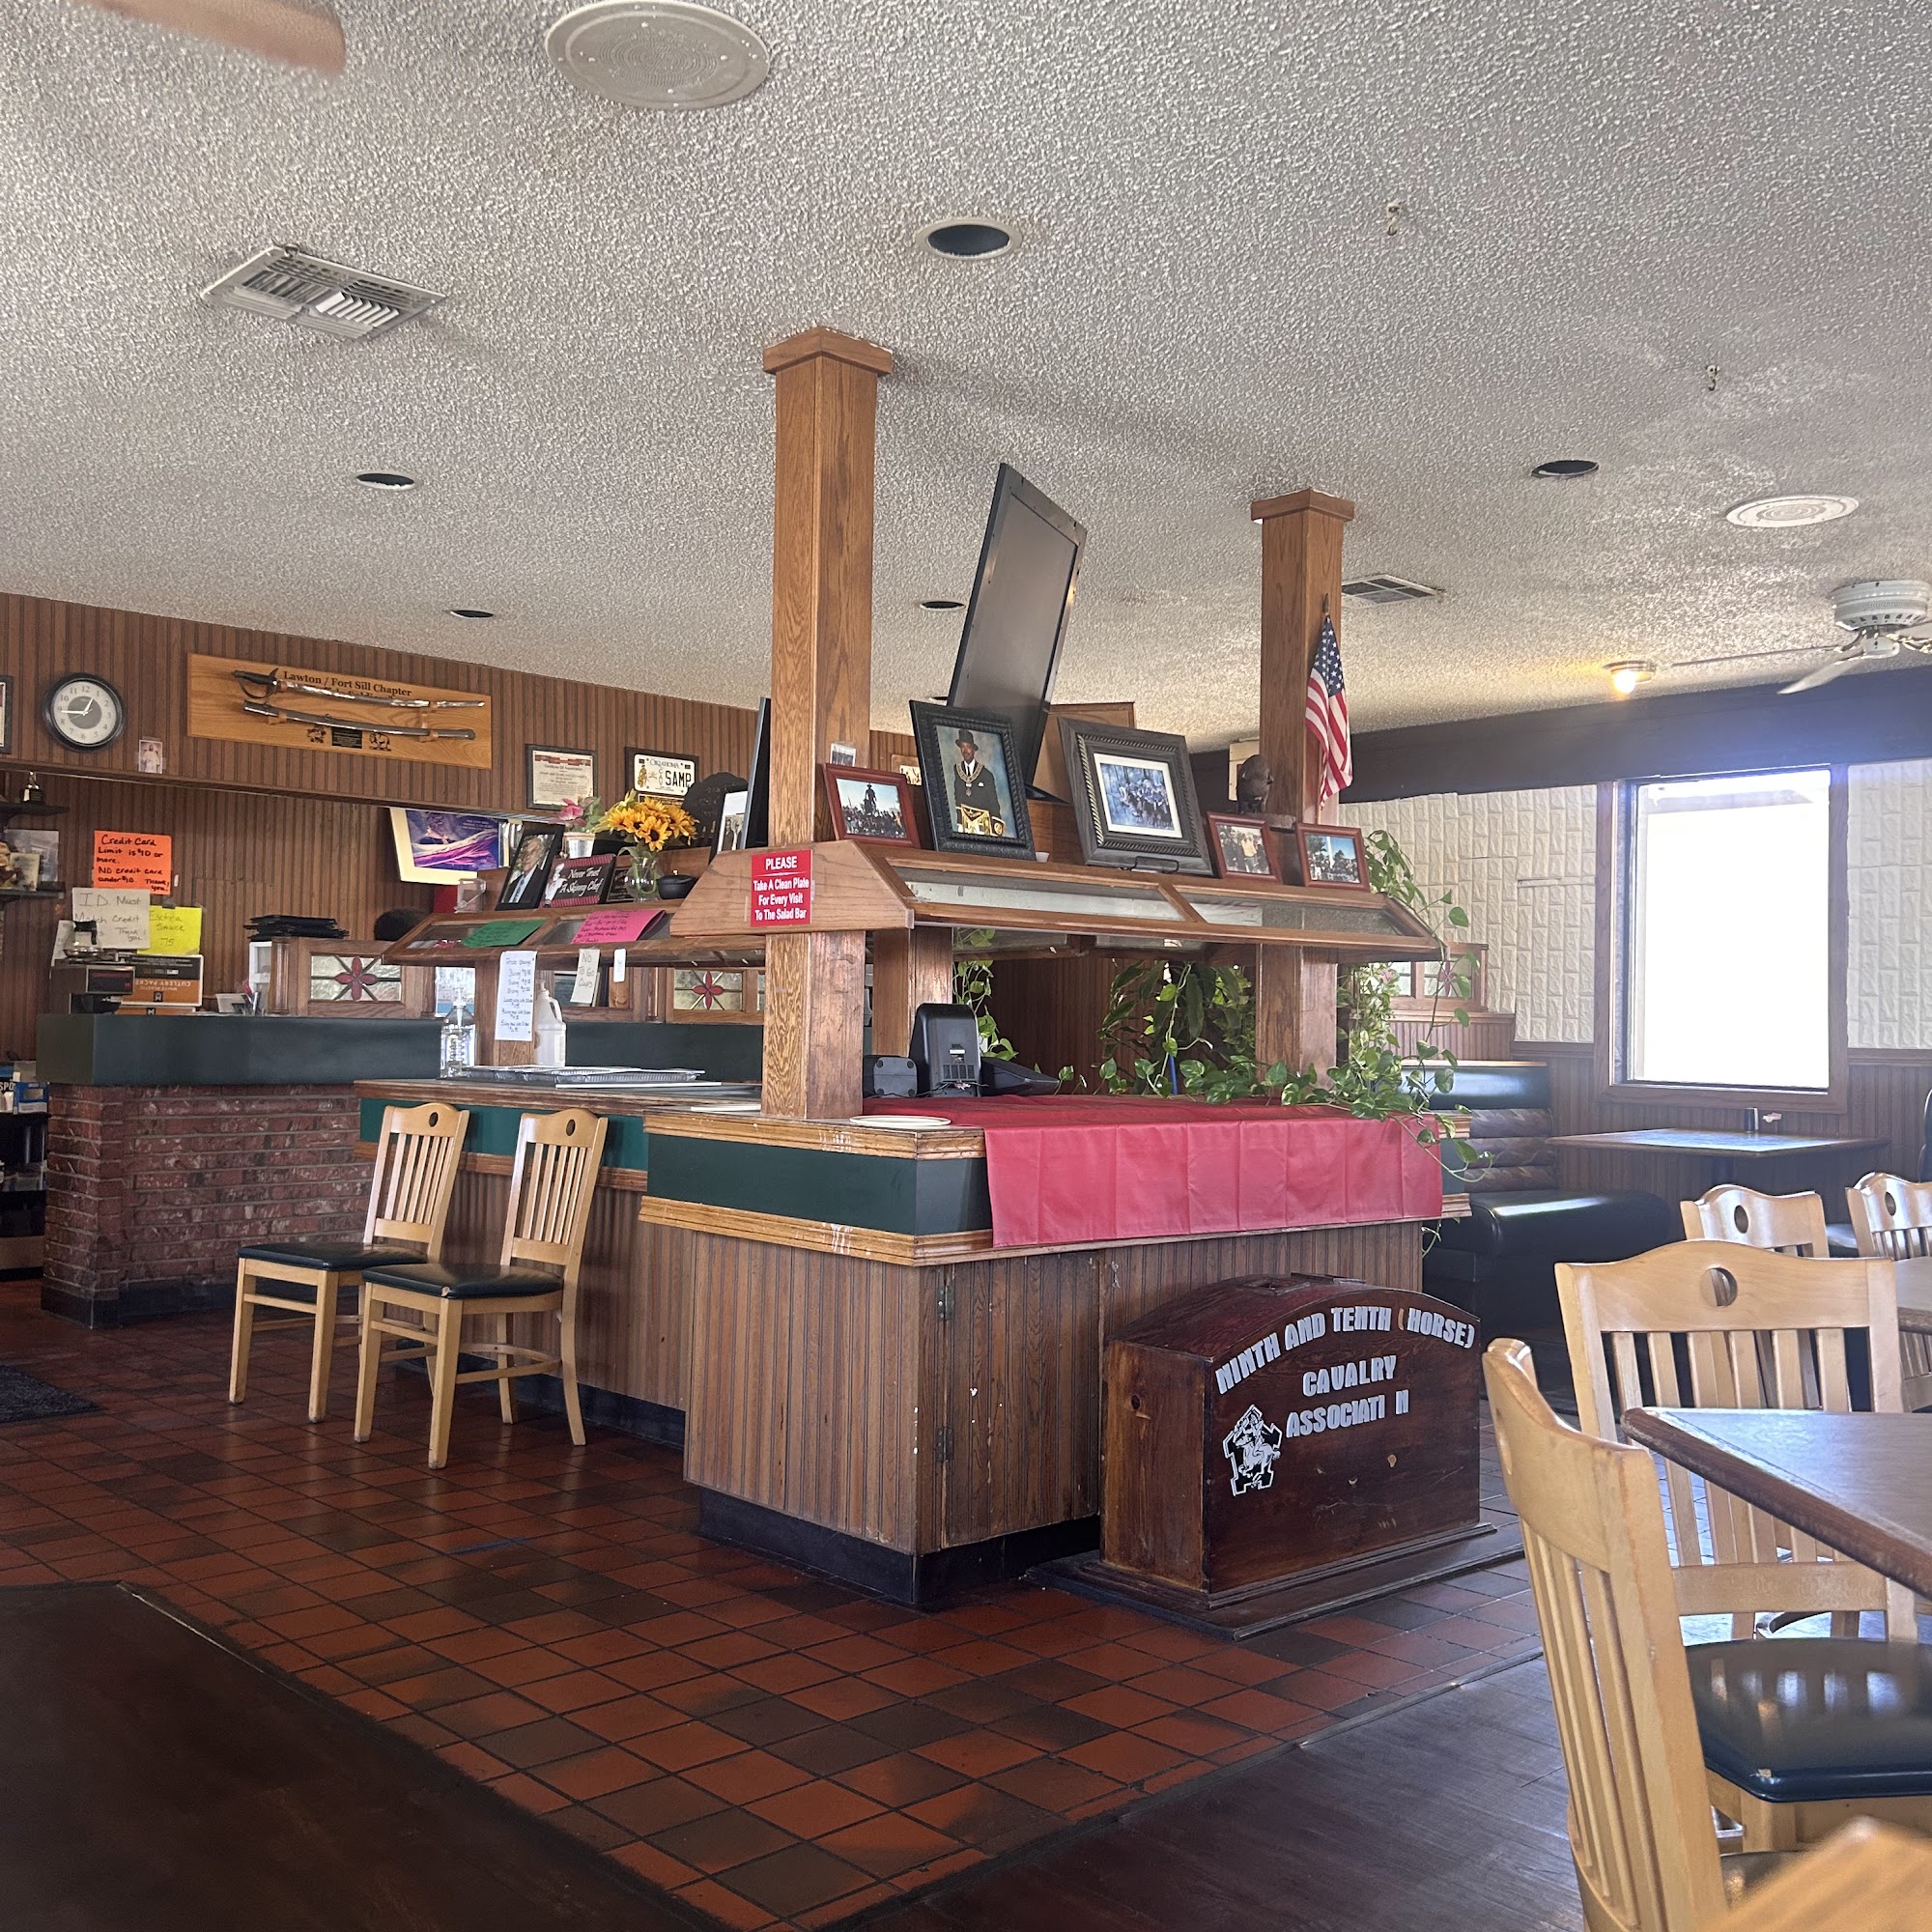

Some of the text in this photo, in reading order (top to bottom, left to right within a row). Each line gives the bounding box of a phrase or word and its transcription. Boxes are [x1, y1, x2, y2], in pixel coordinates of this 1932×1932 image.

[283, 670, 322, 684] Lawton
[324, 676, 329, 686] /
[330, 677, 353, 688] Fort
[355, 680, 371, 692] Sill
[373, 684, 412, 696] Chapter
[101, 834, 156, 846] Credit Card
[137, 848, 151, 857] $10
[765, 856, 798, 870] PLEASE
[568, 866, 603, 879] Never Trust
[559, 882, 568, 894] A
[567, 880, 587, 896] Skinny
[587, 877, 605, 893] Chef
[753, 877, 810, 892] Take A Clean Plate
[117, 895, 142, 906] Must
[758, 893, 803, 907] For Every Visit
[112, 914, 140, 923] Credit
[150, 910, 183, 923] Extra
[754, 907, 807, 922] To The Salad Bar
[1214, 1332, 1281, 1395] NINTH
[1284, 1312, 1326, 1351] AND
[1330, 1306, 1392, 1332] TENTH
[1302, 1354, 1397, 1397] CAVALRY
